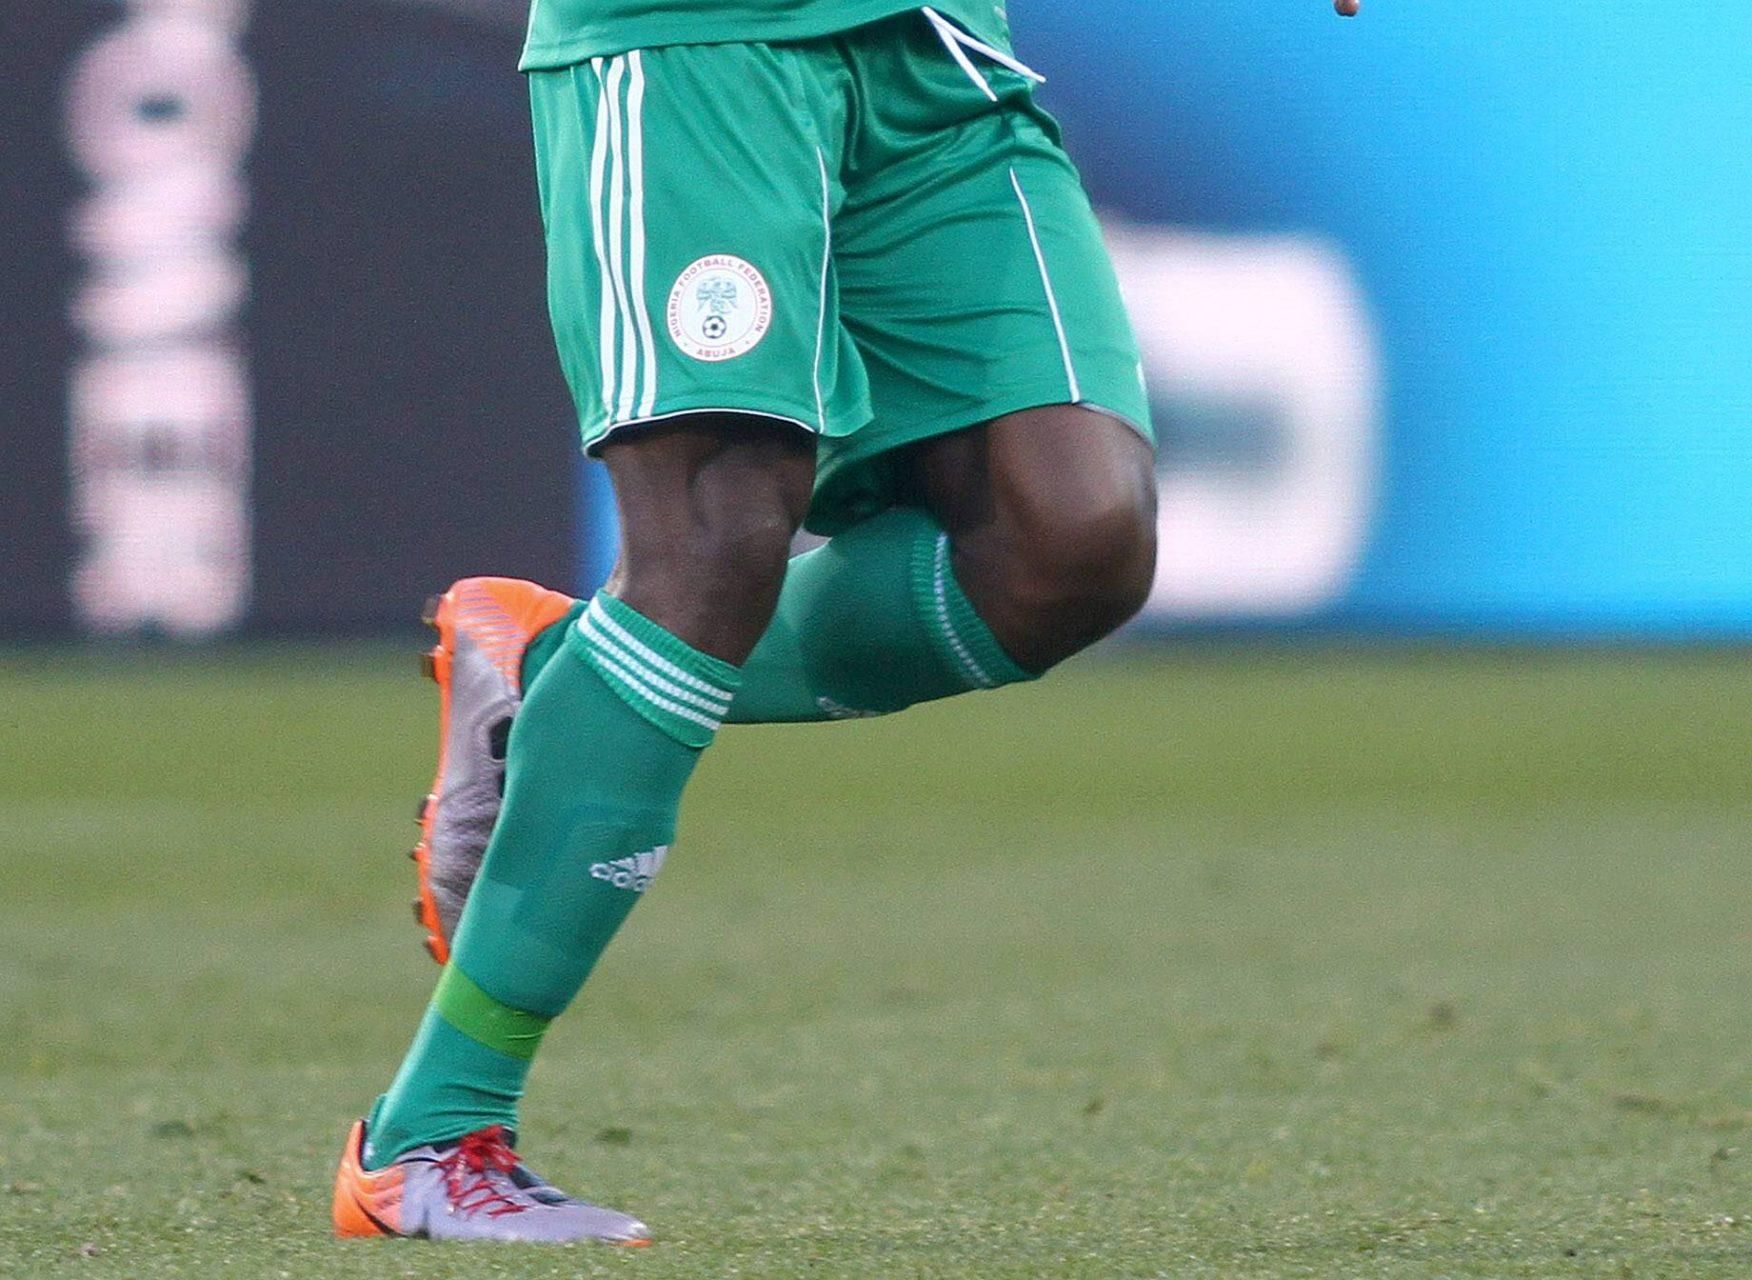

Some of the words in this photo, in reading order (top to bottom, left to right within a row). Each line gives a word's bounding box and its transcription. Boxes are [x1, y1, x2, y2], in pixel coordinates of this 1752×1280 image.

[669, 290, 682, 338] NIGERIA
[679, 258, 734, 287] FOOTBALL
[738, 263, 769, 333] FEDERATION
[696, 347, 737, 358] ABUJA
